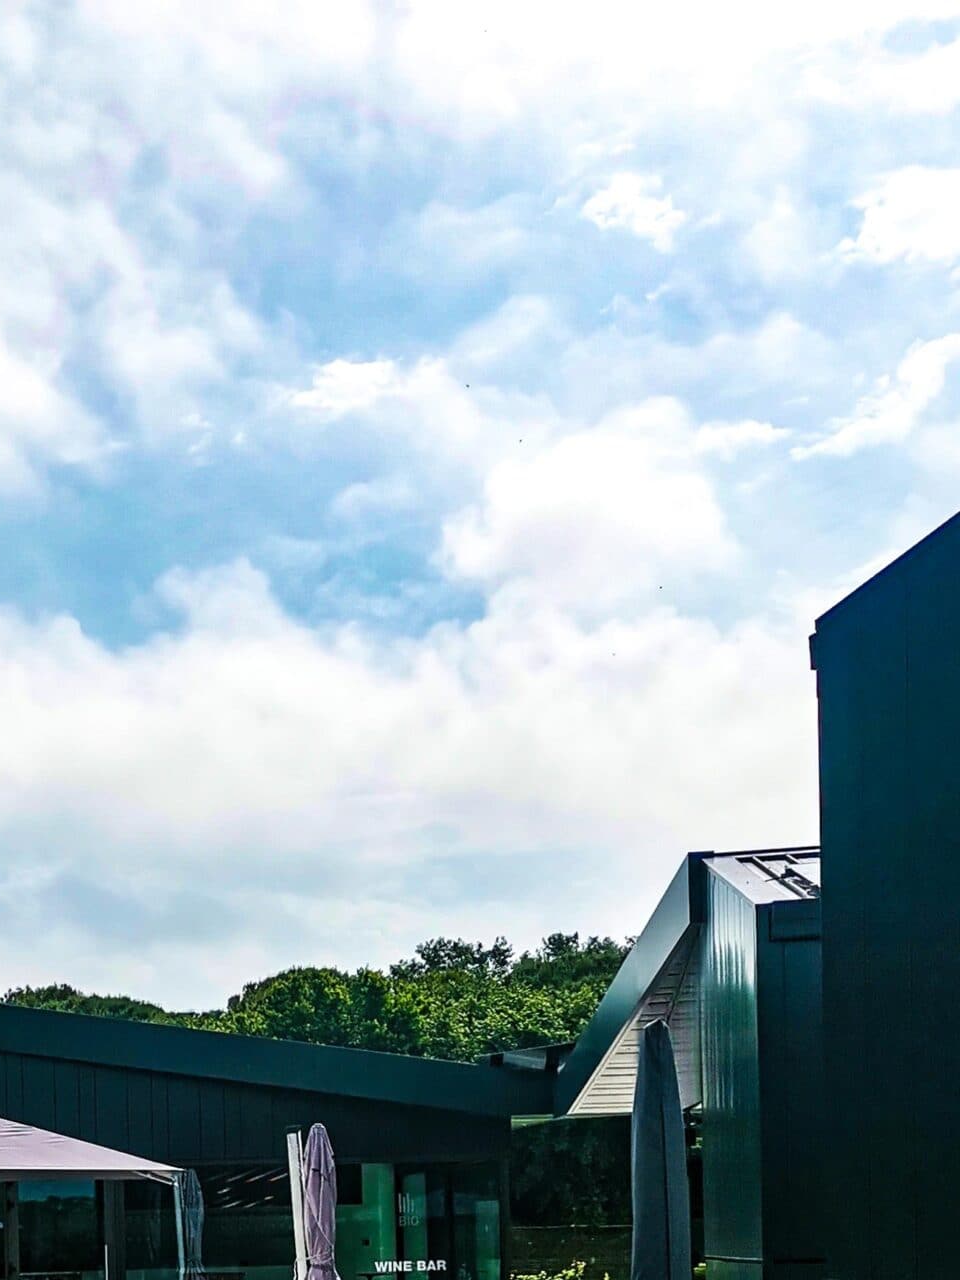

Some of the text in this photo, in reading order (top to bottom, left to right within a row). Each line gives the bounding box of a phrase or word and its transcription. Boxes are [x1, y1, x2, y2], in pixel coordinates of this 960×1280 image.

[399, 1215, 419, 1226] BIO
[374, 1259, 447, 1273] WINE BAR
